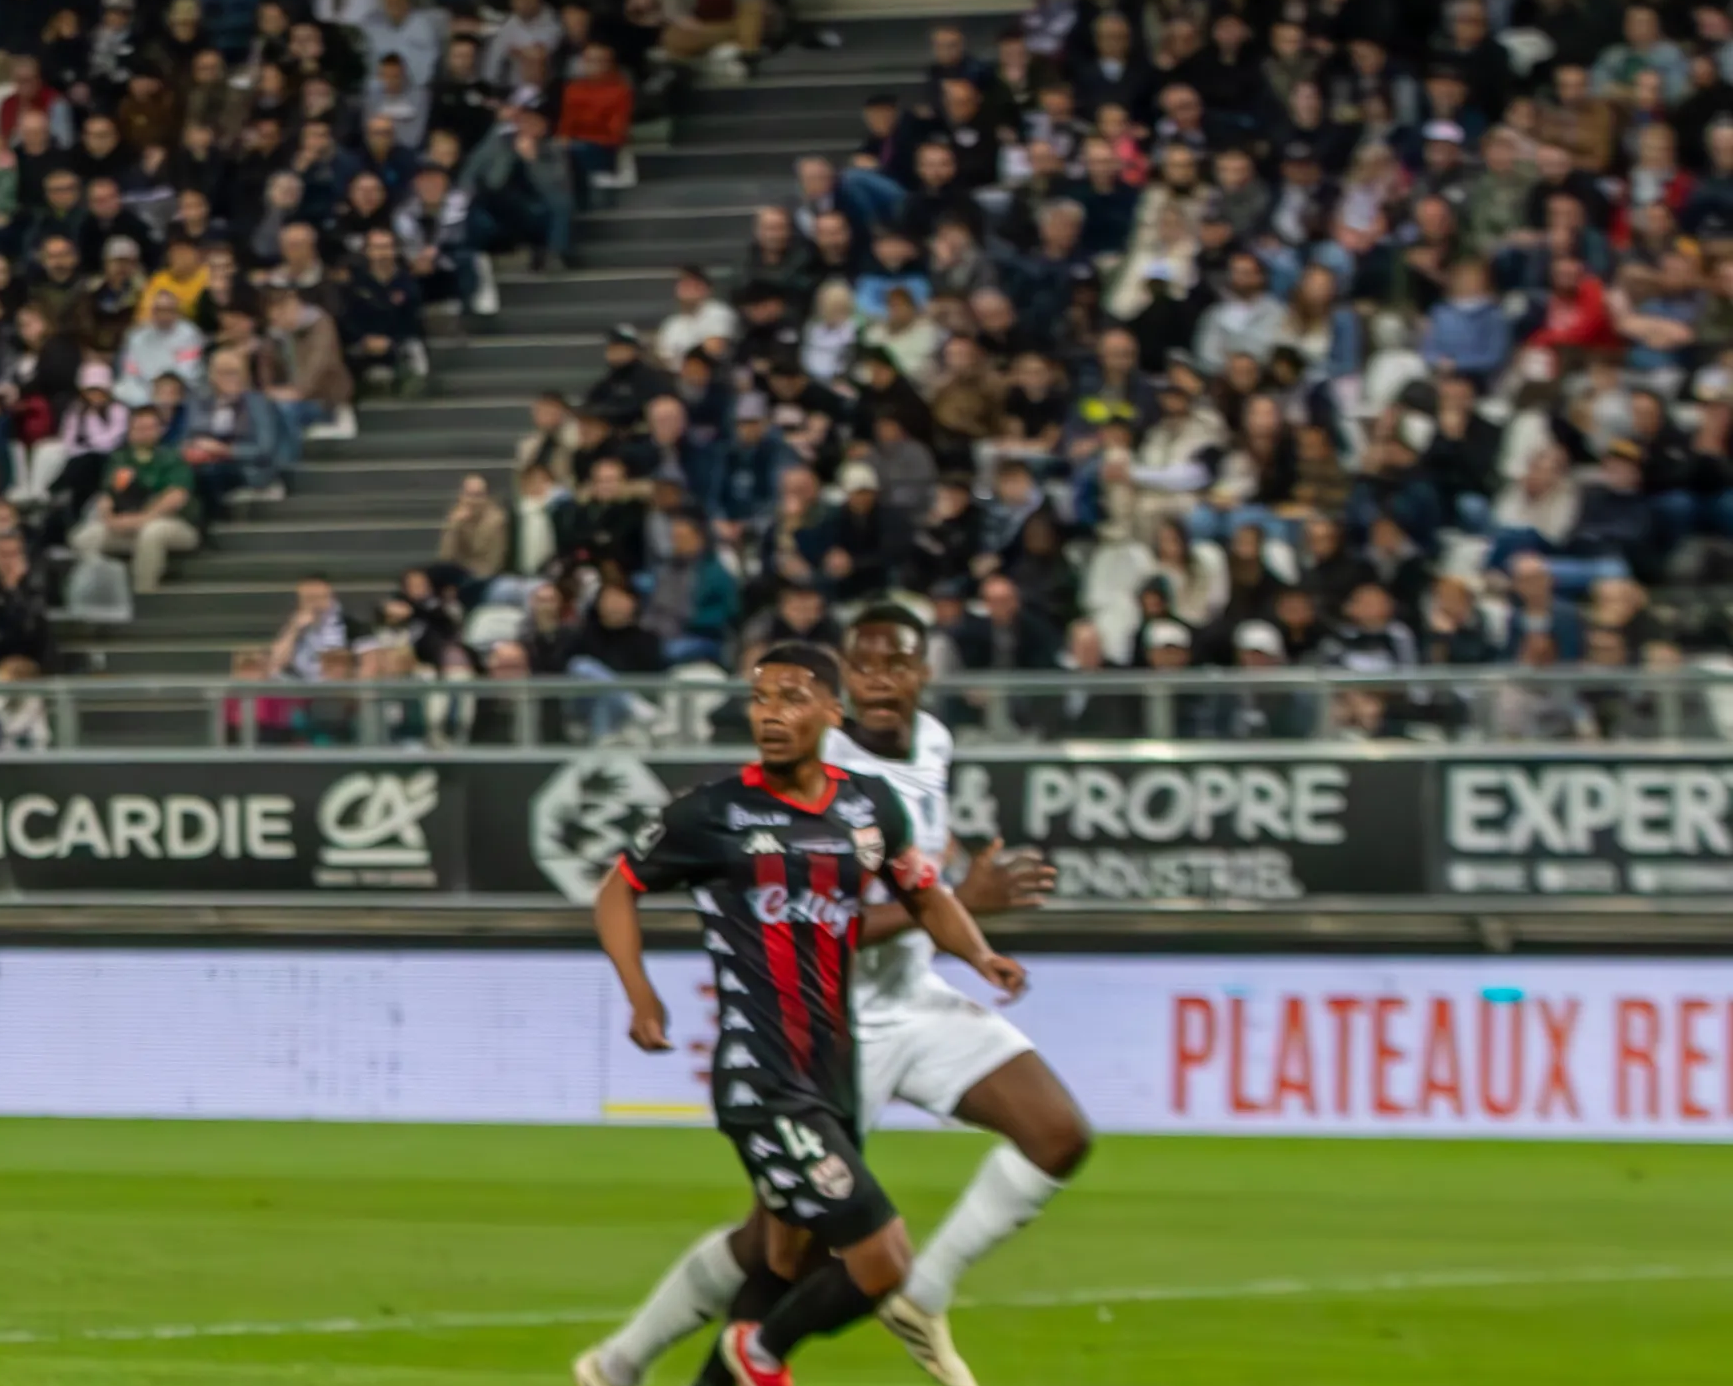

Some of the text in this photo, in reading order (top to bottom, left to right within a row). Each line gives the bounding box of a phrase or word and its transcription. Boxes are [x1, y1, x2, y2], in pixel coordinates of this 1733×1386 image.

[1023, 766, 1348, 844] PROPRE
[1446, 764, 1733, 855] EXPER
[1171, 995, 1581, 1119] PLATEAUX
